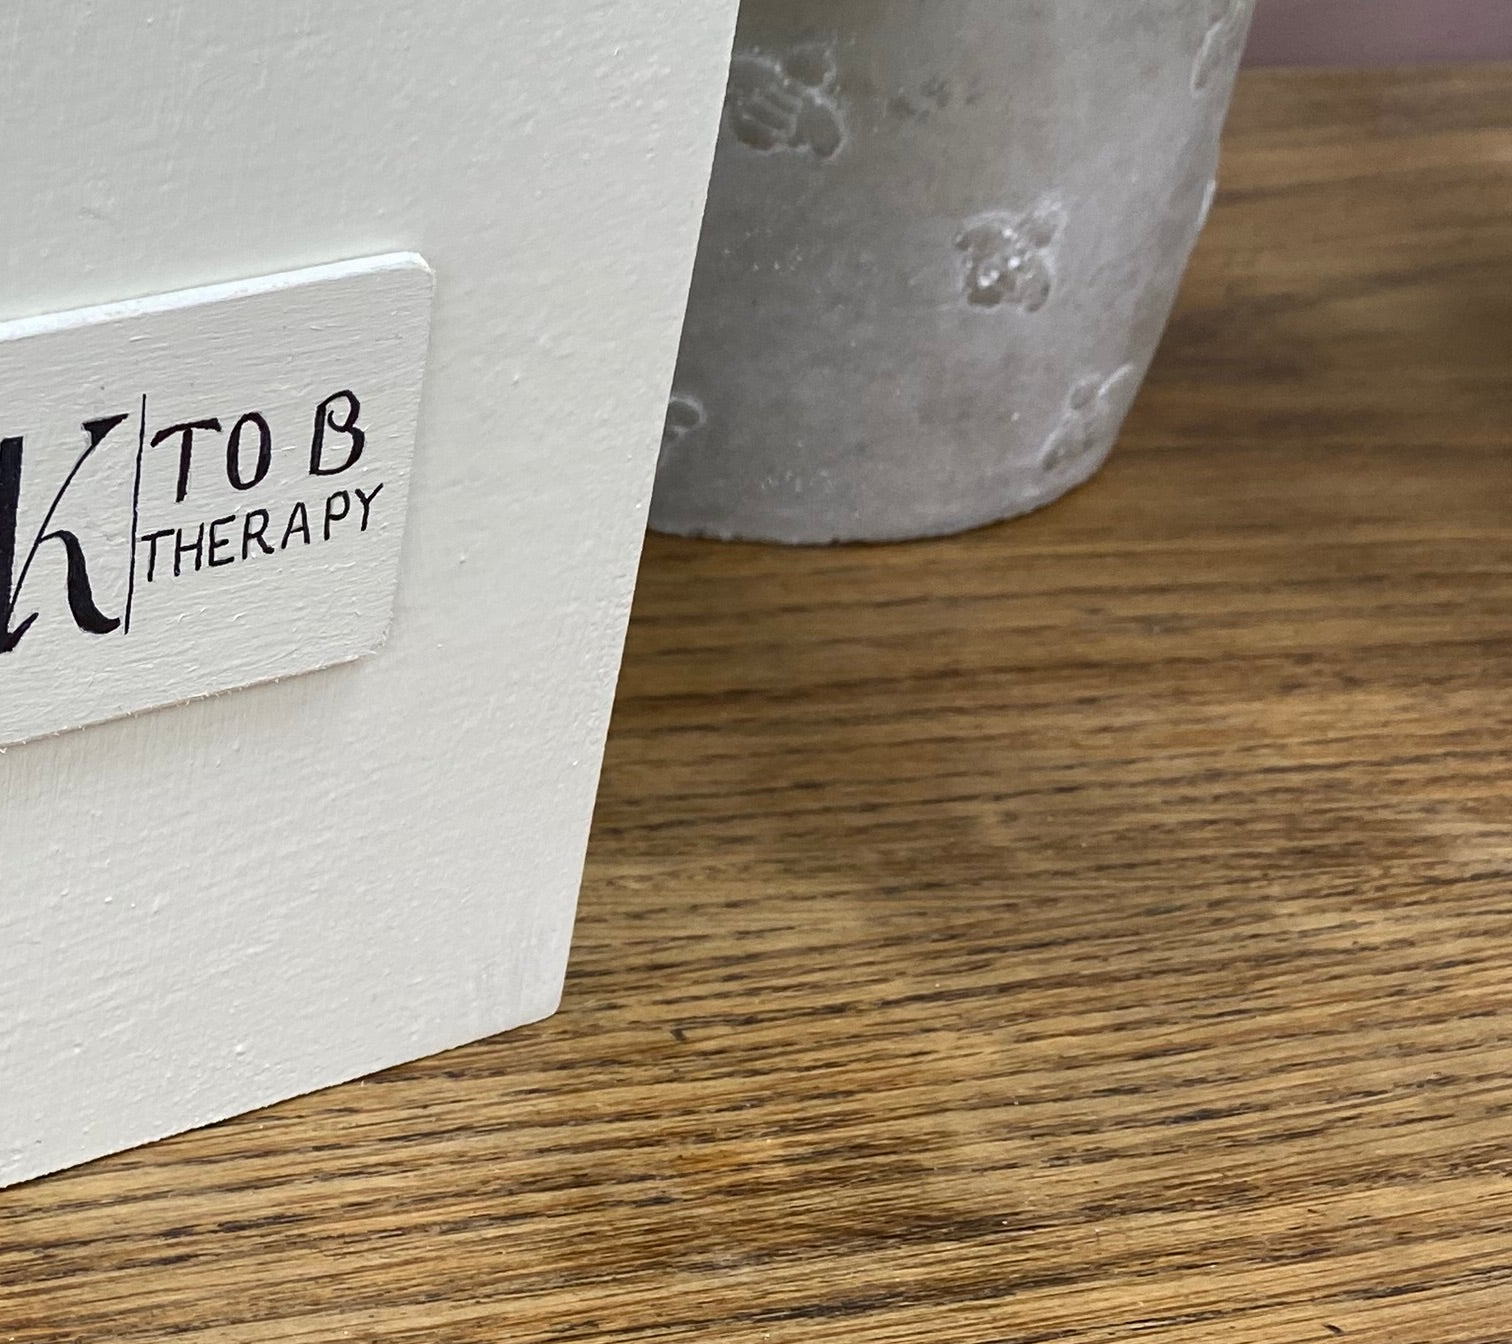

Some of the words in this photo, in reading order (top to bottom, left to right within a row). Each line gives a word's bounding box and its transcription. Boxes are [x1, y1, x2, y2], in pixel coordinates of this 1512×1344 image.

[150, 411, 273, 504] TO
[308, 389, 366, 477] B
[140, 482, 385, 583] THERAPY
